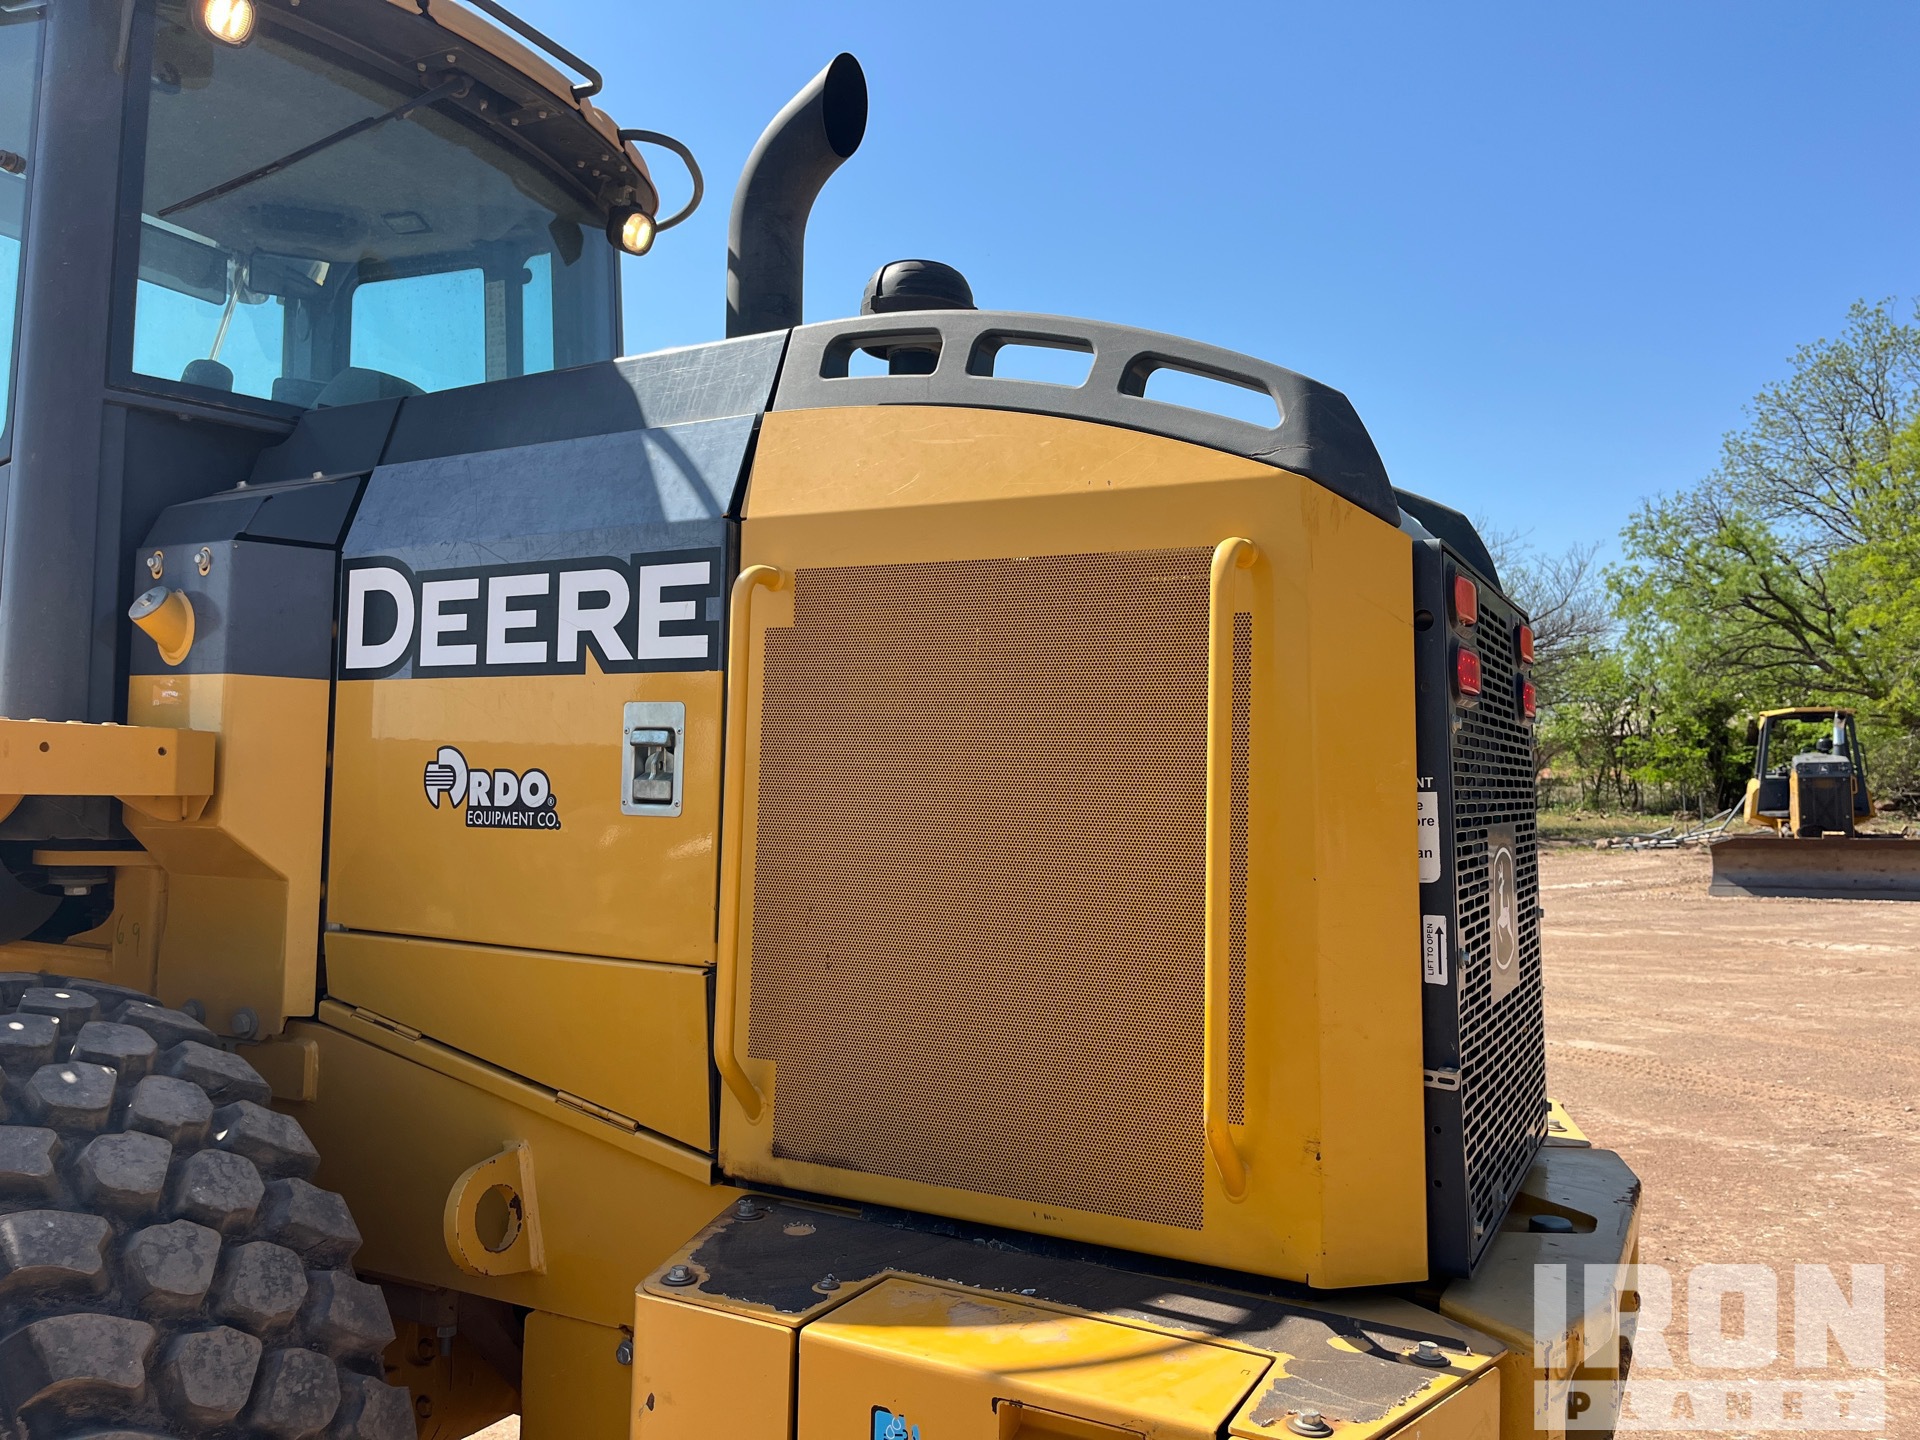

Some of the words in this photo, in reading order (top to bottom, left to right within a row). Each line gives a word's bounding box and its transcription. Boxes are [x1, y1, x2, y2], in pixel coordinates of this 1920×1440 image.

[345, 561, 711, 670] DEERE
[467, 810, 535, 826] EQUIPMENT
[537, 812, 560, 827] CO.
[1426, 923, 1434, 945] OPEN
[1426, 946, 1434, 957] TO
[1427, 959, 1435, 976] LIFT
